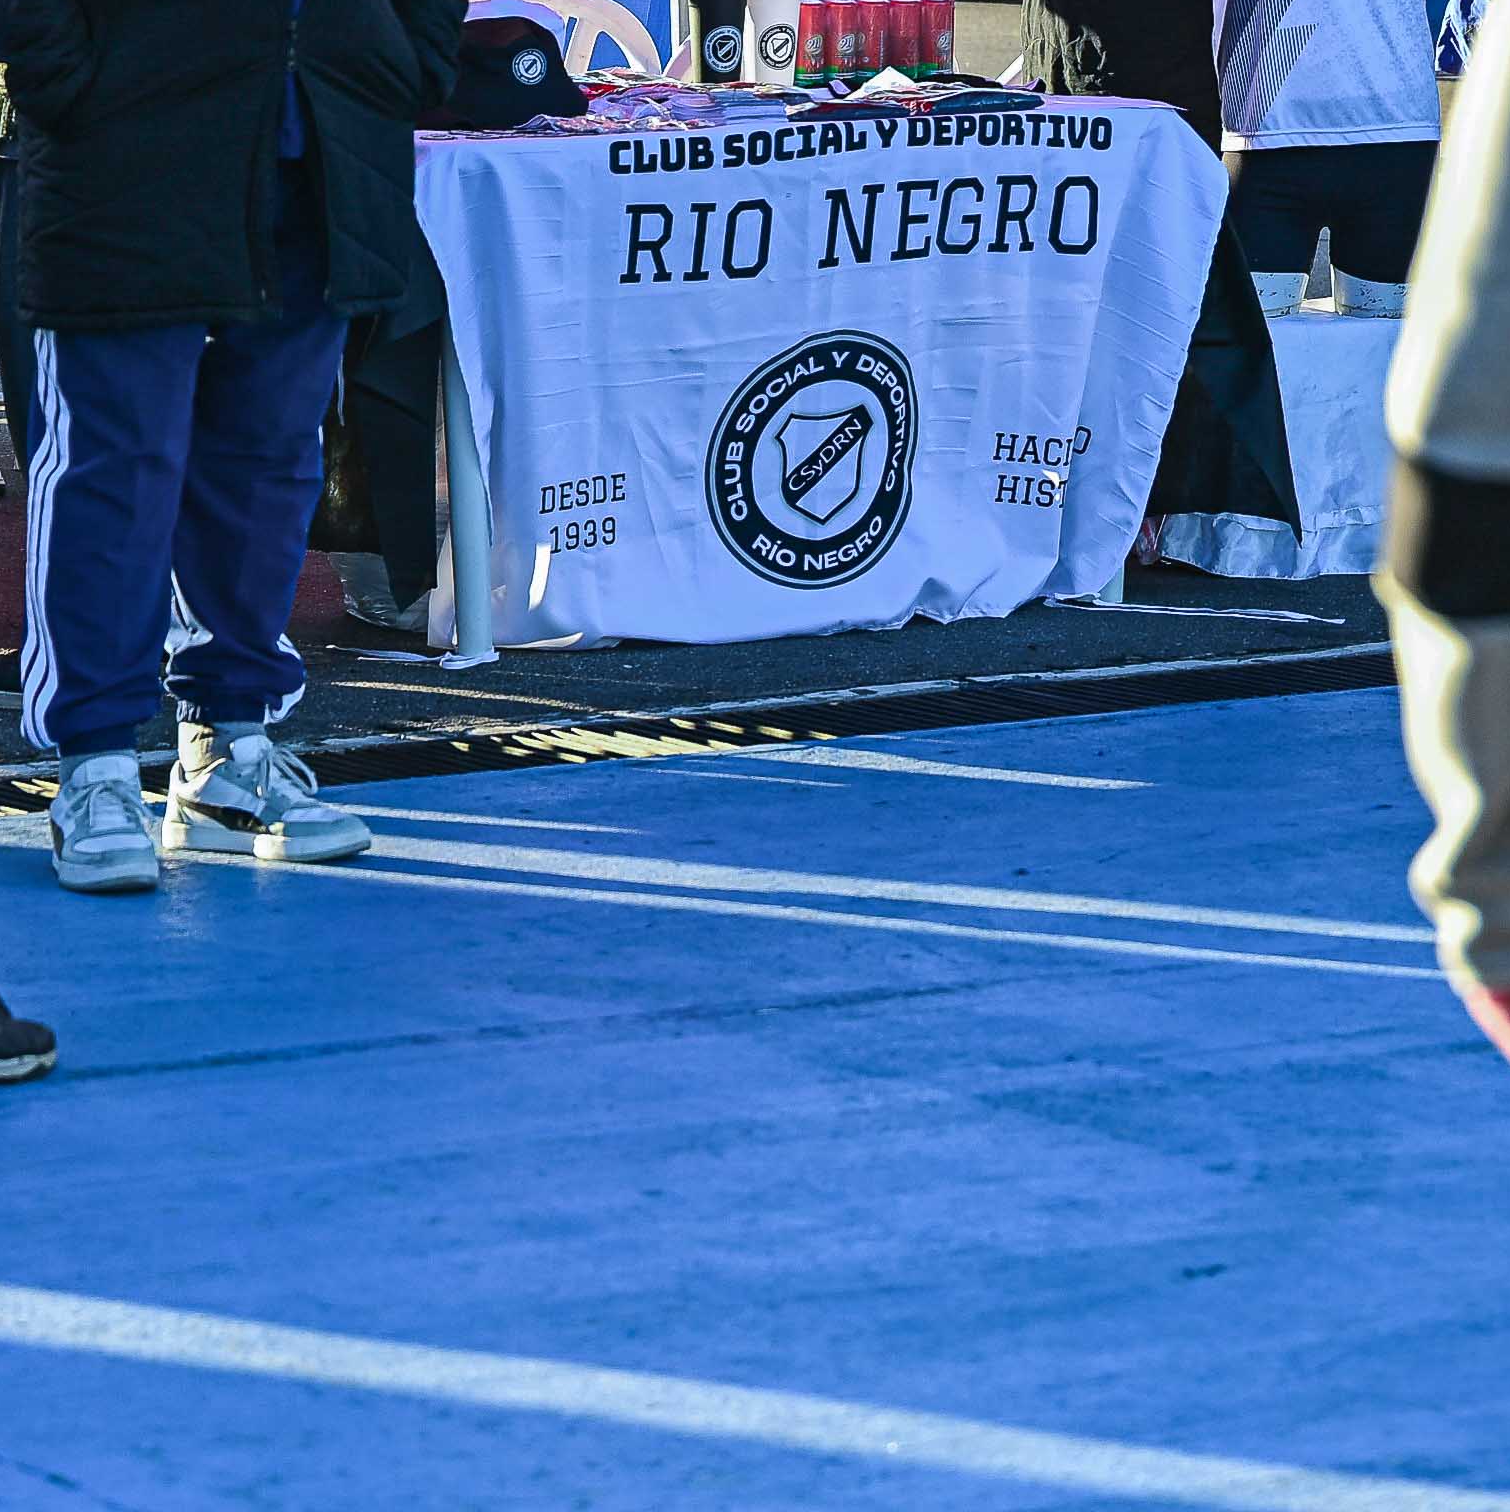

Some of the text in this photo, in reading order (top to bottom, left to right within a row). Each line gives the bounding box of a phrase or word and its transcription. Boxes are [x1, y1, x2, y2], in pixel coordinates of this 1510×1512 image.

[609, 114, 1112, 175] CLUB SOCIAL Y DEPORTIVO
[620, 175, 1099, 284] RIO NEGRO
[724, 351, 907, 521] CLUB SOCIAL Y DEPORTIVO
[788, 419, 862, 491] CSyDRN
[539, 473, 626, 514] DESDE
[550, 517, 616, 554] 1939
[752, 515, 882, 571] RÍO NEGRO
